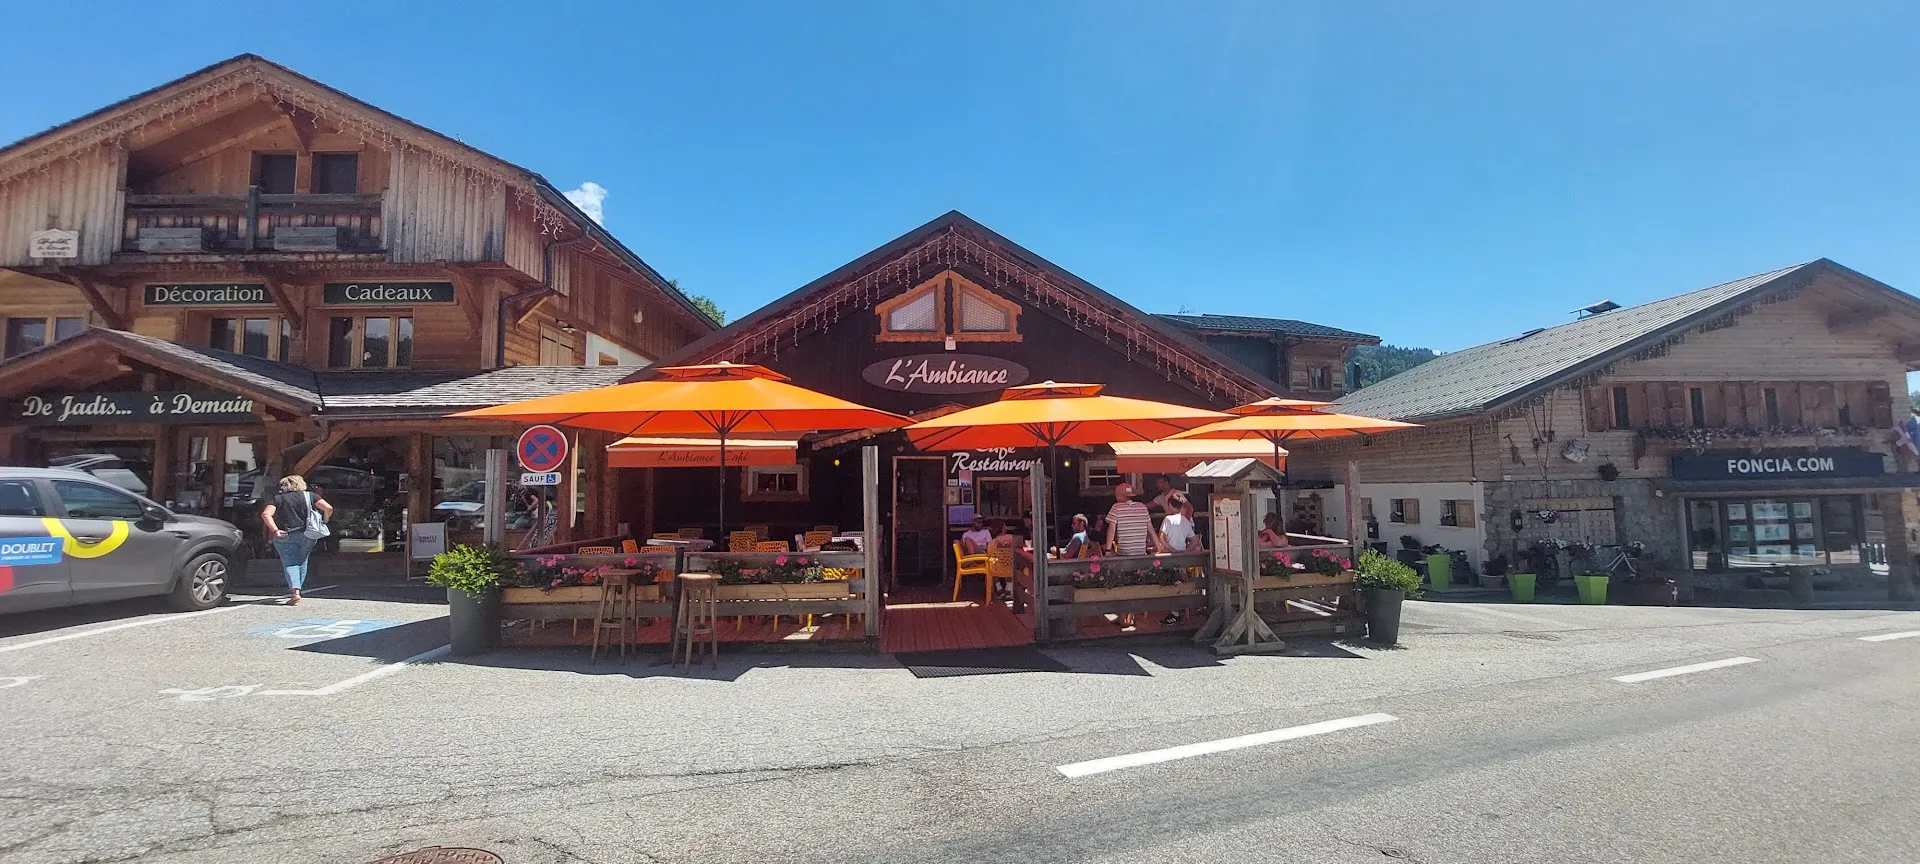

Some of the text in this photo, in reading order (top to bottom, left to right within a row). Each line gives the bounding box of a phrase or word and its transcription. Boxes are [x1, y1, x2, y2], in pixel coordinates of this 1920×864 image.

[154, 285, 264, 302] Décoration
[345, 284, 433, 300] Cadeaux
[885, 358, 1008, 390] L'Ambiance
[22, 393, 254, 422] De Jadis... à Demain
[1, 543, 56, 554] DOUBLET
